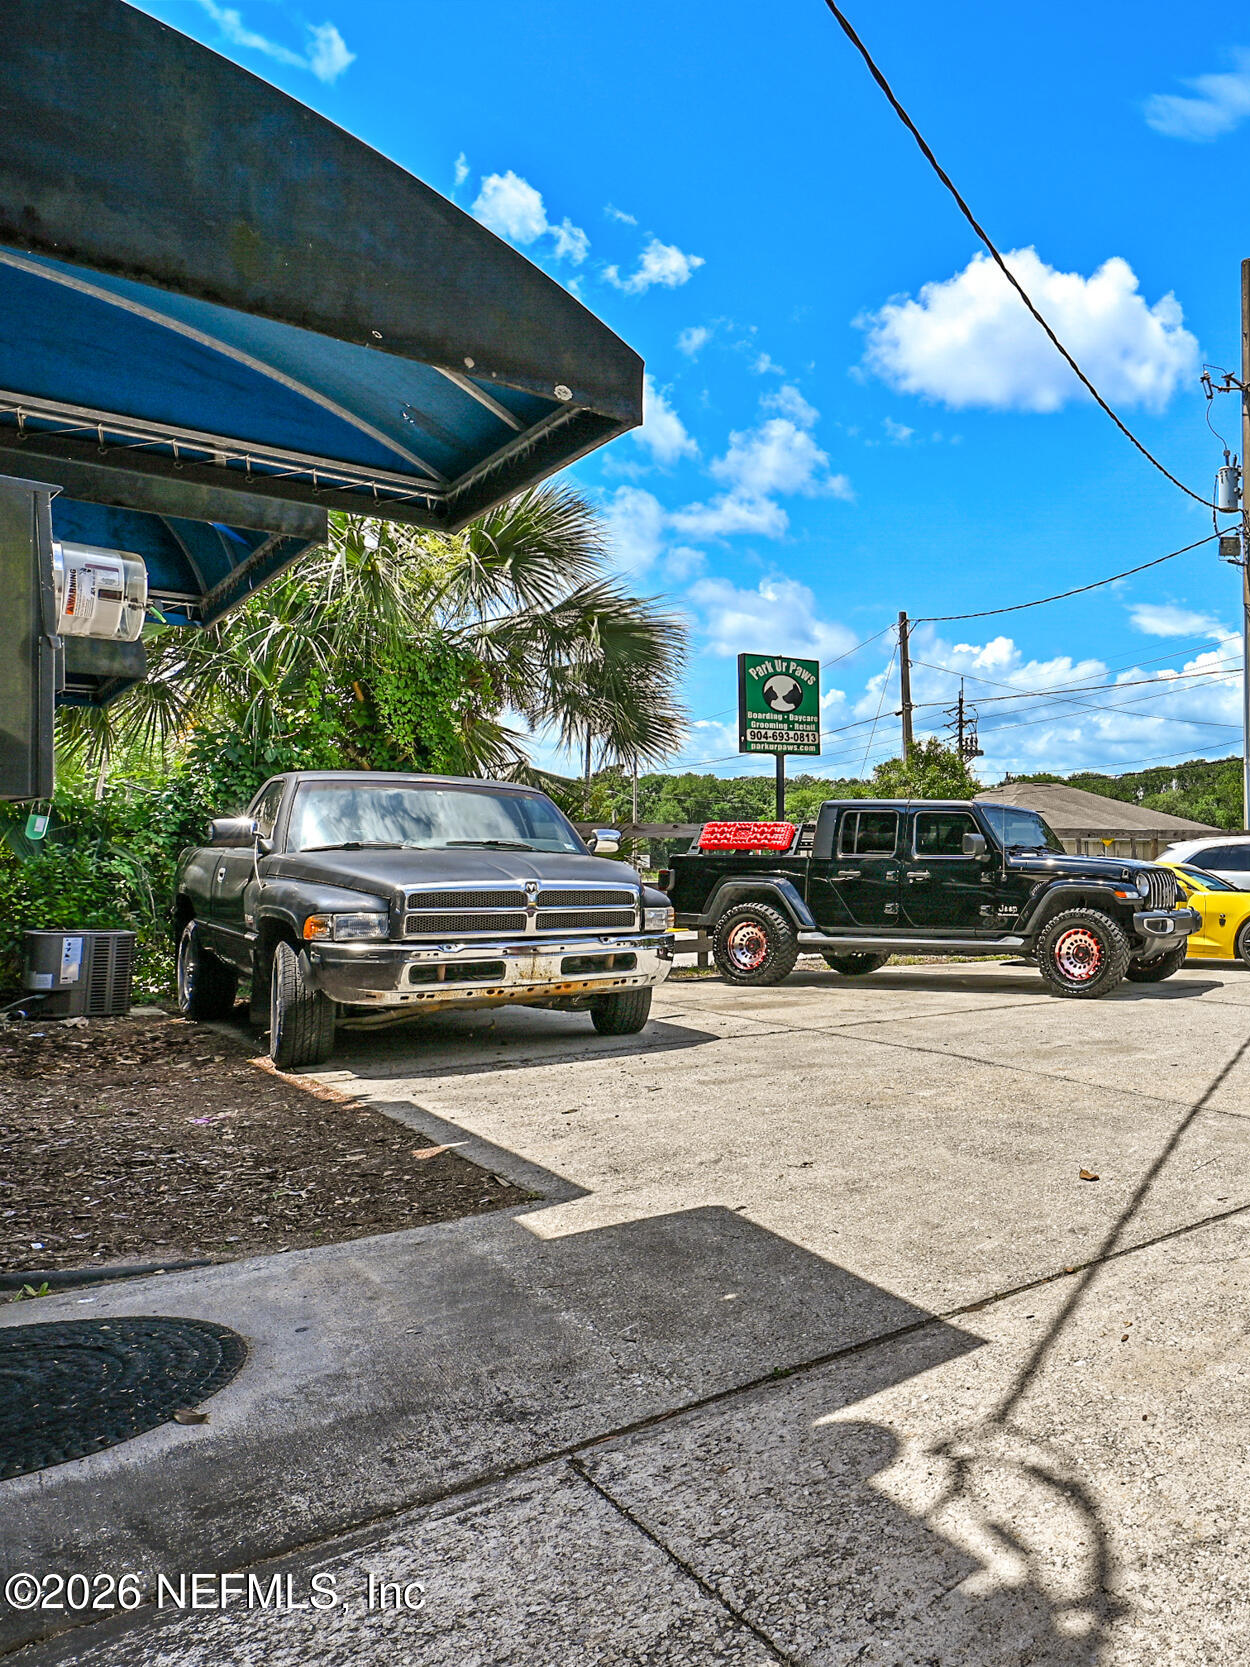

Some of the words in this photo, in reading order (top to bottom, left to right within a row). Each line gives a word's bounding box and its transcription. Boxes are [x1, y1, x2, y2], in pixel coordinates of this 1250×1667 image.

[67, 568, 77, 605] WARNING
[748, 660, 774, 680] Park
[774, 659, 787, 672] Ur
[789, 661, 816, 685] Paws
[747, 711, 783, 721] Boarding
[789, 713, 818, 723] Daycare
[751, 720, 788, 731] Grooming
[794, 723, 816, 731] Retail
[750, 730, 817, 743] 904-693-0813
[751, 743, 816, 752] parkurpaws.com
